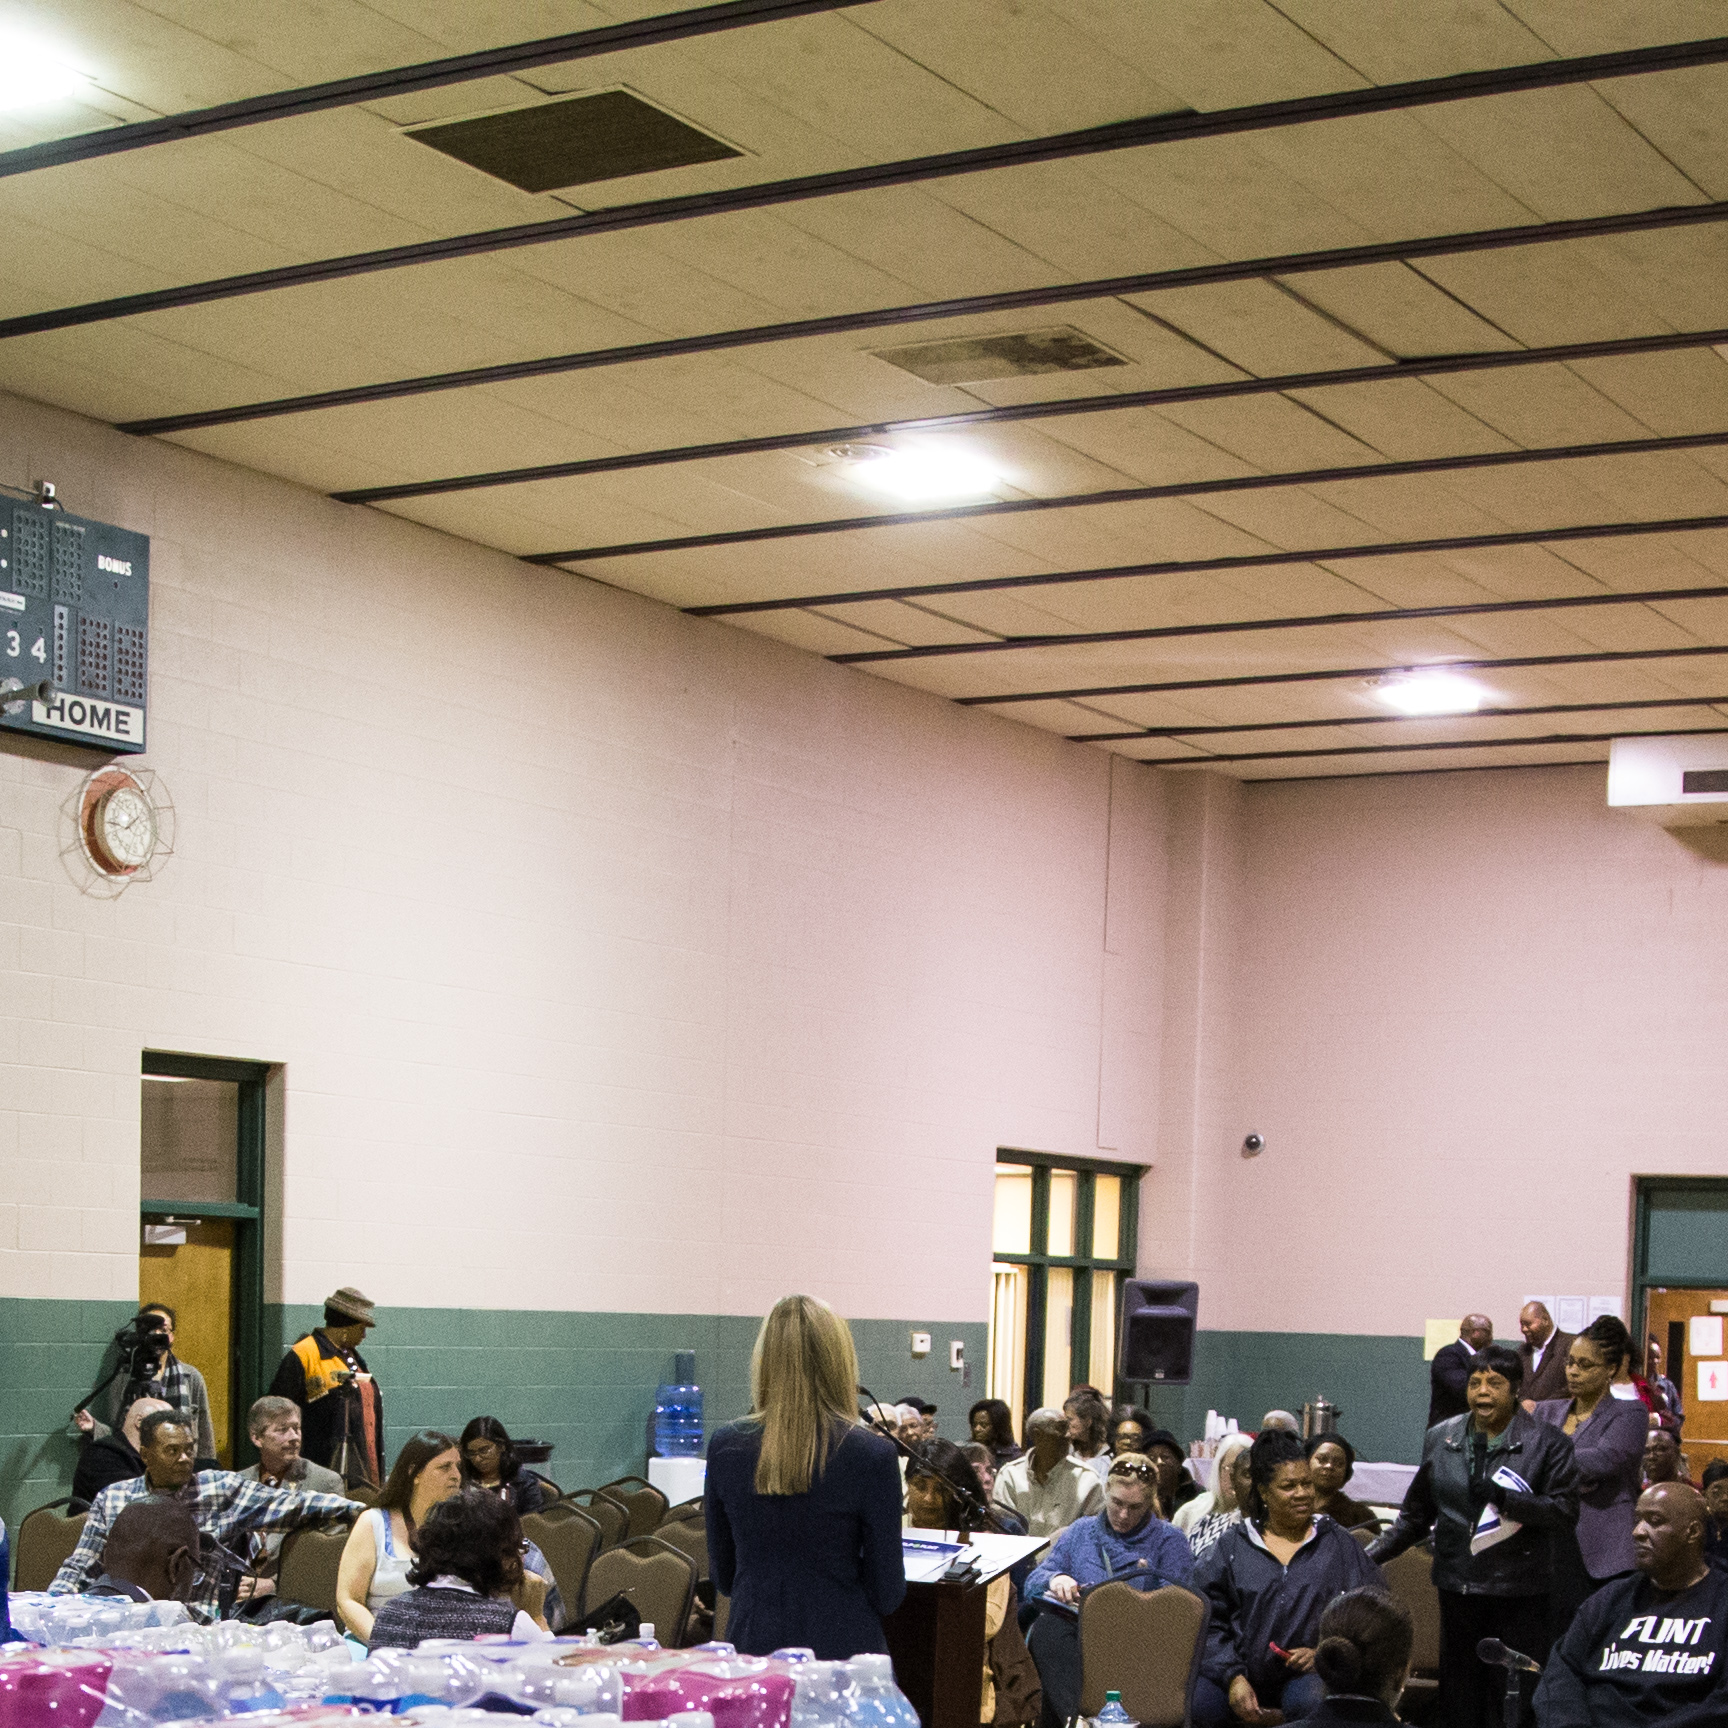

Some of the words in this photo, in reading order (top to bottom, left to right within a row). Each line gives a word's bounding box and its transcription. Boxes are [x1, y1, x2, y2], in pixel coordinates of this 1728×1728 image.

[97, 554, 133, 577] BONUS
[6, 629, 21, 658] 3
[31, 636, 47, 665] 4
[46, 698, 132, 736] HOME
[1619, 1615, 1712, 1646] FLINT
[1598, 1641, 1643, 1672] Lives
[1641, 1649, 1716, 1675] Matter!
